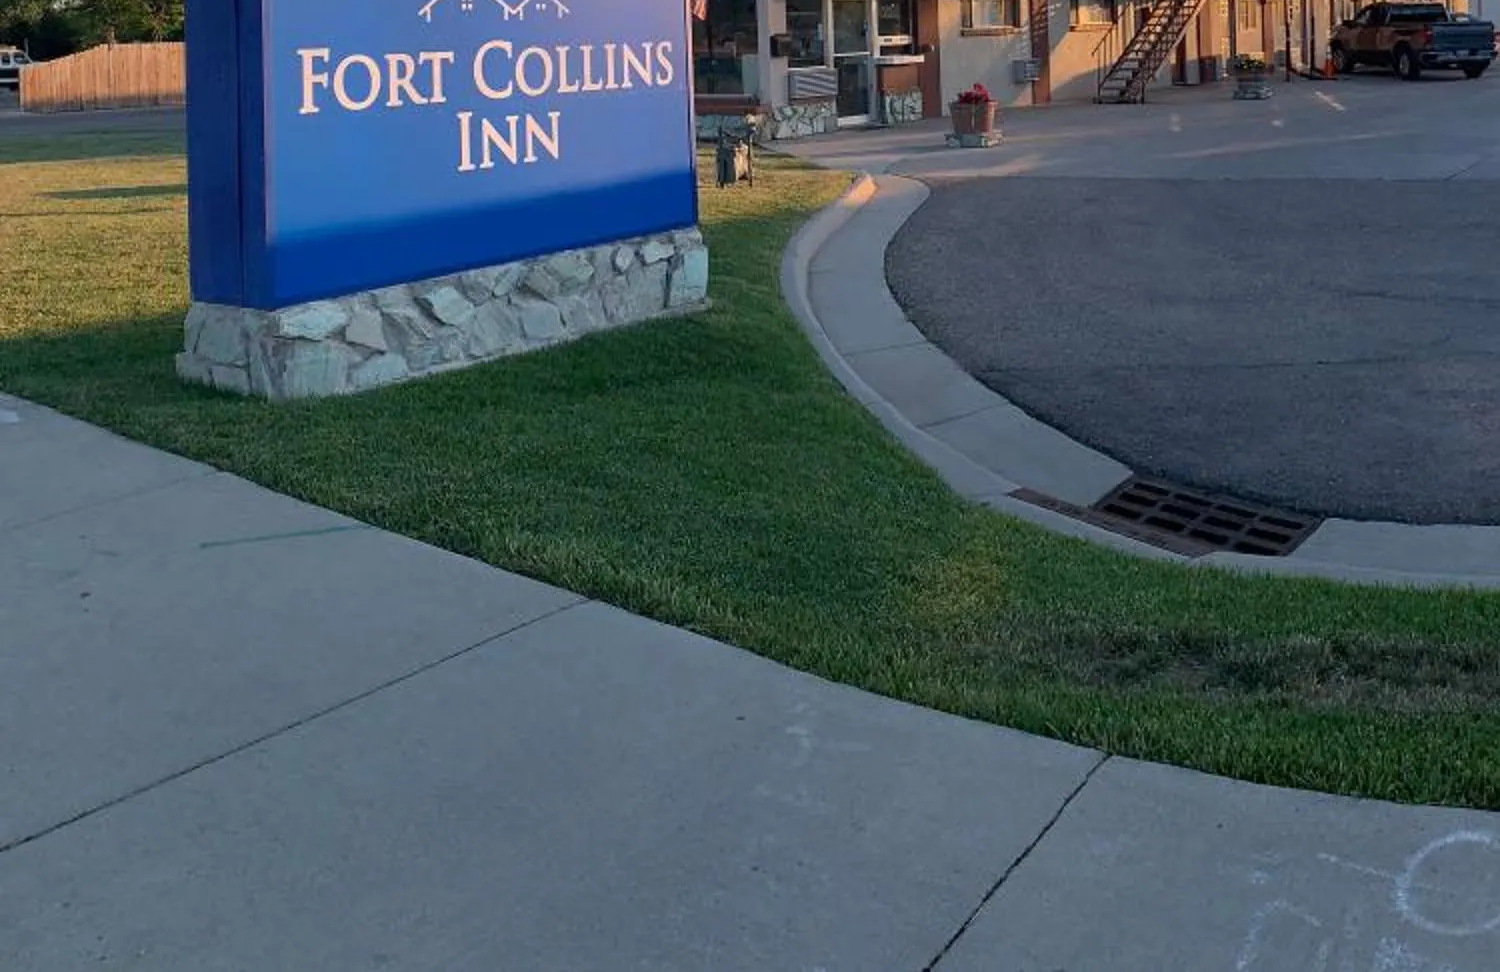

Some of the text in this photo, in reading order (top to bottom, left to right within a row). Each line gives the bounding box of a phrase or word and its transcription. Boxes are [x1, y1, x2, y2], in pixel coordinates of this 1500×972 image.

[297, 40, 674, 115] FORT COLLINS
[456, 111, 561, 173] INN
